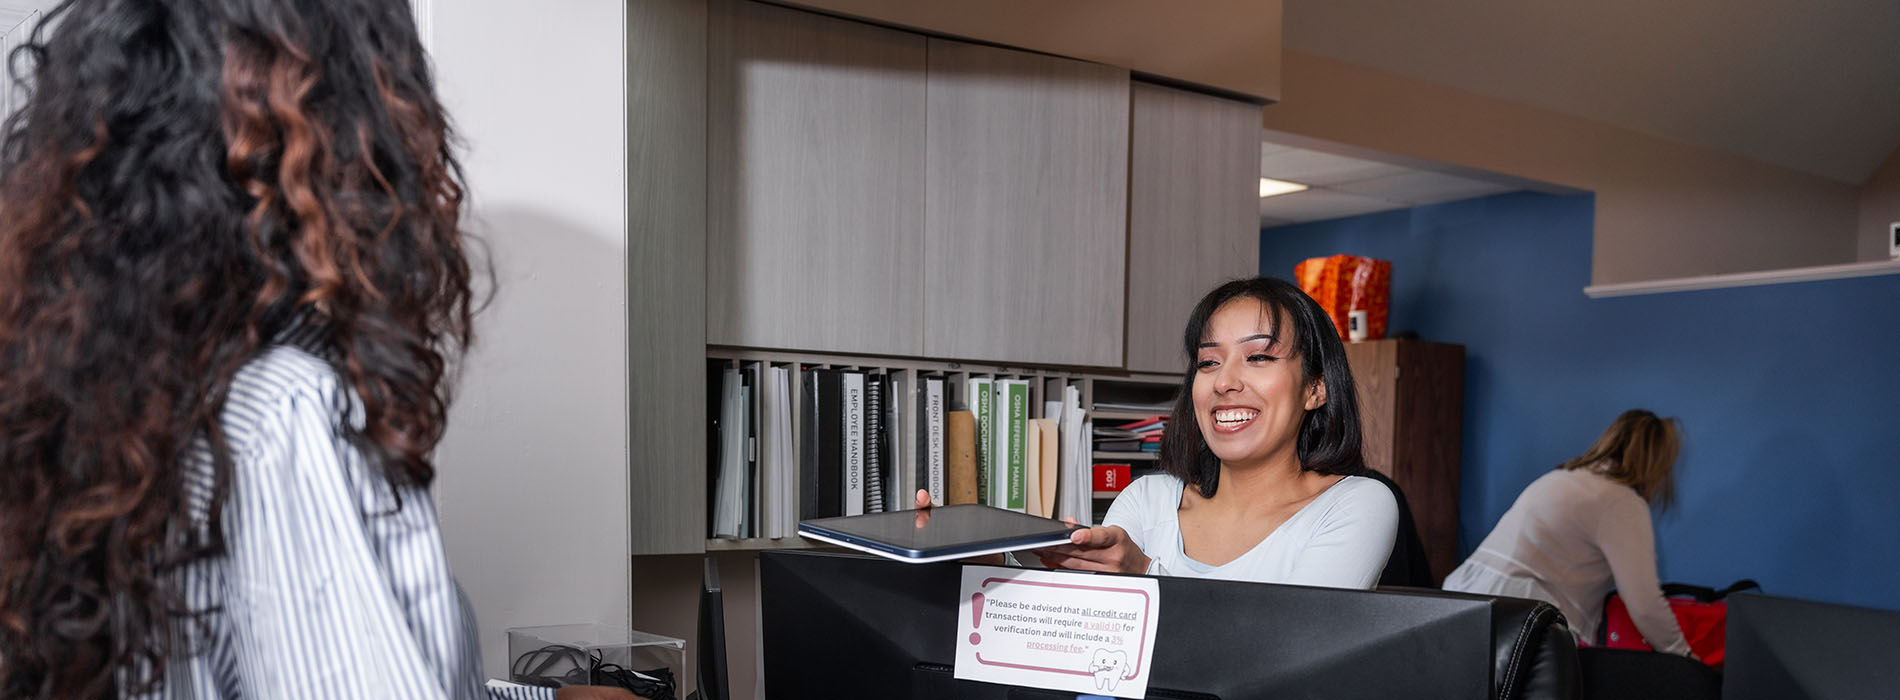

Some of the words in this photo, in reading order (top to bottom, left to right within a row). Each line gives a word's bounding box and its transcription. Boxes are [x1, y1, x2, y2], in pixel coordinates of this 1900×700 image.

[850, 388, 859, 437] EMPLOYEE
[932, 394, 940, 424] FRONT
[981, 390, 989, 414] OSHA
[1014, 394, 1022, 418] OSHA
[932, 425, 940, 448] DESK
[1013, 419, 1021, 465] REFERENCE
[850, 438, 859, 490] HANDBOOK
[932, 450, 940, 500] HANDBOOK
[1012, 465, 1020, 500] MANUAL
[985, 611, 1038, 624] transactions
[1039, 616, 1053, 625] will
[1054, 619, 1082, 628] require
[1090, 621, 1110, 631] valid
[1112, 622, 1121, 632] ID
[1122, 623, 1135, 632] for
[1019, 601, 1030, 610] be
[1031, 604, 1062, 613] advised
[1064, 606, 1080, 615] that
[1081, 608, 1092, 617] all
[1093, 609, 1117, 618] credit
[1119, 612, 1137, 620] card
[994, 624, 1041, 636] verification
[1042, 630, 1057, 638] and
[1058, 631, 1073, 639] will
[1073, 631, 1104, 642] include
[1026, 641, 1069, 653] processing
